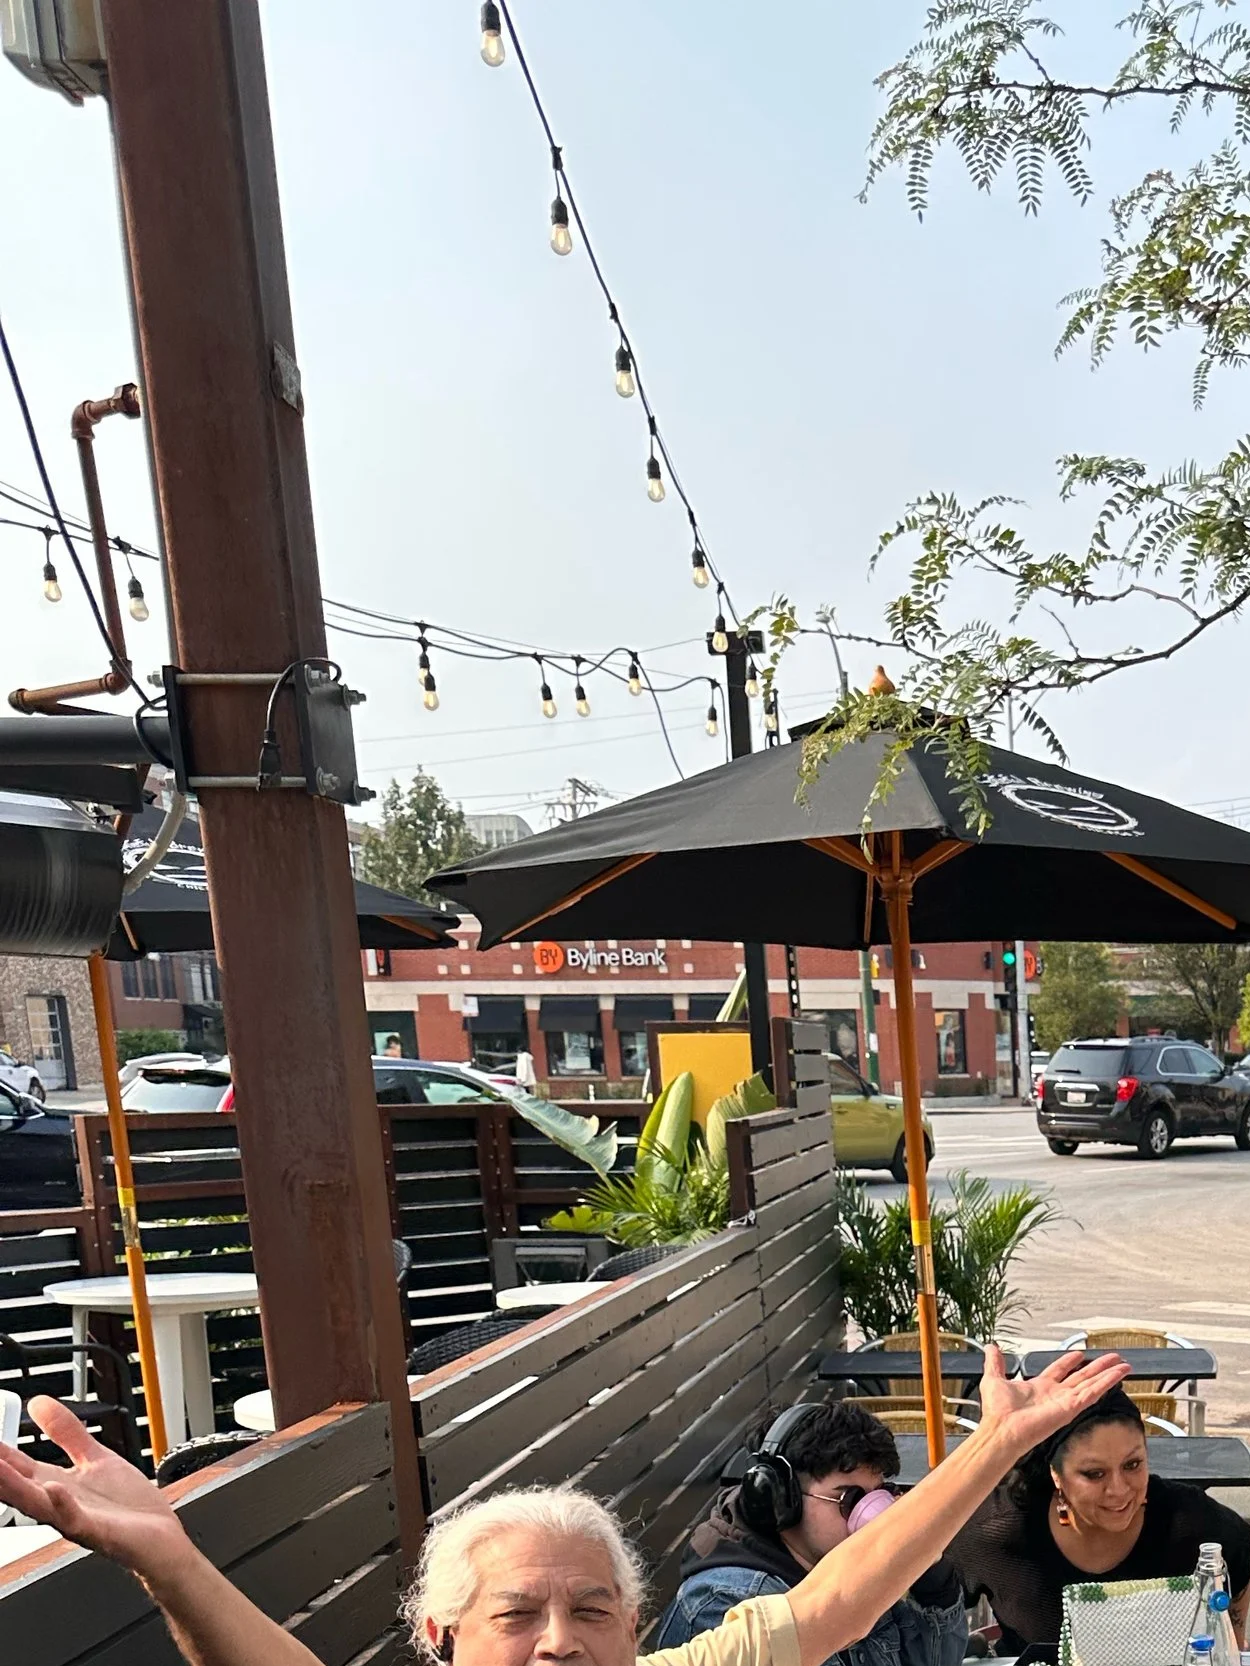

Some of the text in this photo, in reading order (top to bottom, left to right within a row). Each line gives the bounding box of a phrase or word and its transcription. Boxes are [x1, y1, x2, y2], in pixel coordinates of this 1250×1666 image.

[539, 948, 558, 965] BY
[566, 947, 667, 969] Byline Bank
